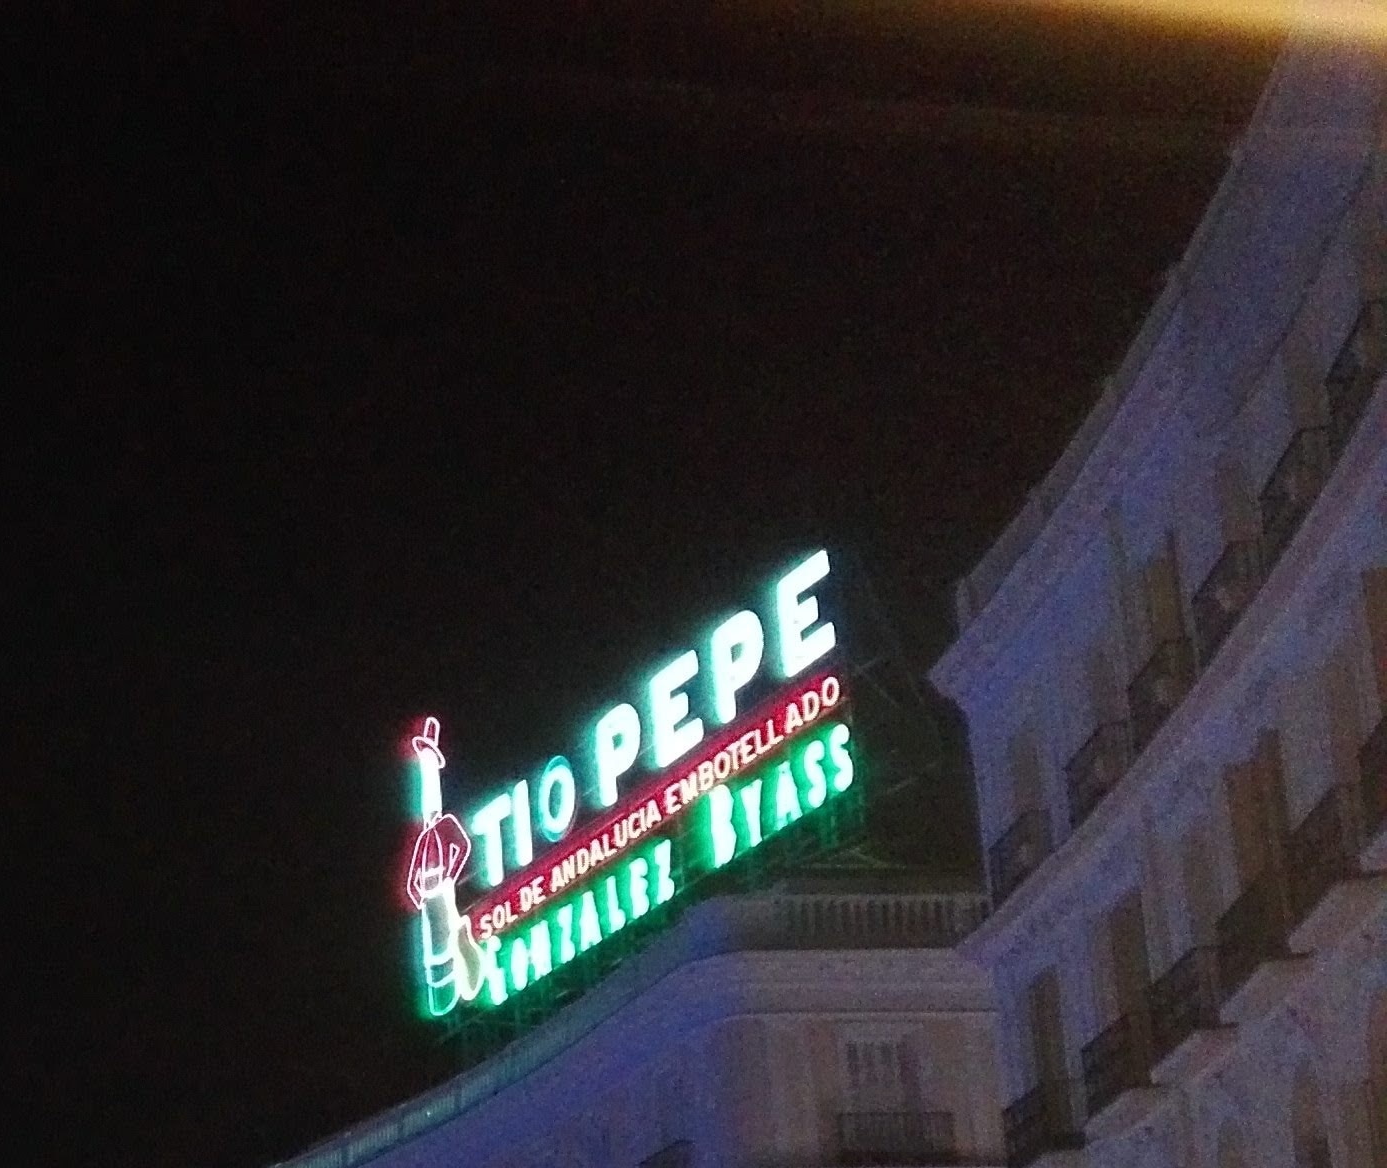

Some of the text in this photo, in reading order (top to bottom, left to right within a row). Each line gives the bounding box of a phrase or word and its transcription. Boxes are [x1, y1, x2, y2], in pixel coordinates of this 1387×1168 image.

[470, 549, 837, 887] TIO PEPE
[479, 901, 519, 939] SOL
[519, 875, 547, 912] DE
[549, 799, 663, 893] ANDALUCIA
[485, 723, 854, 1006] GONZALEZ BYASS
